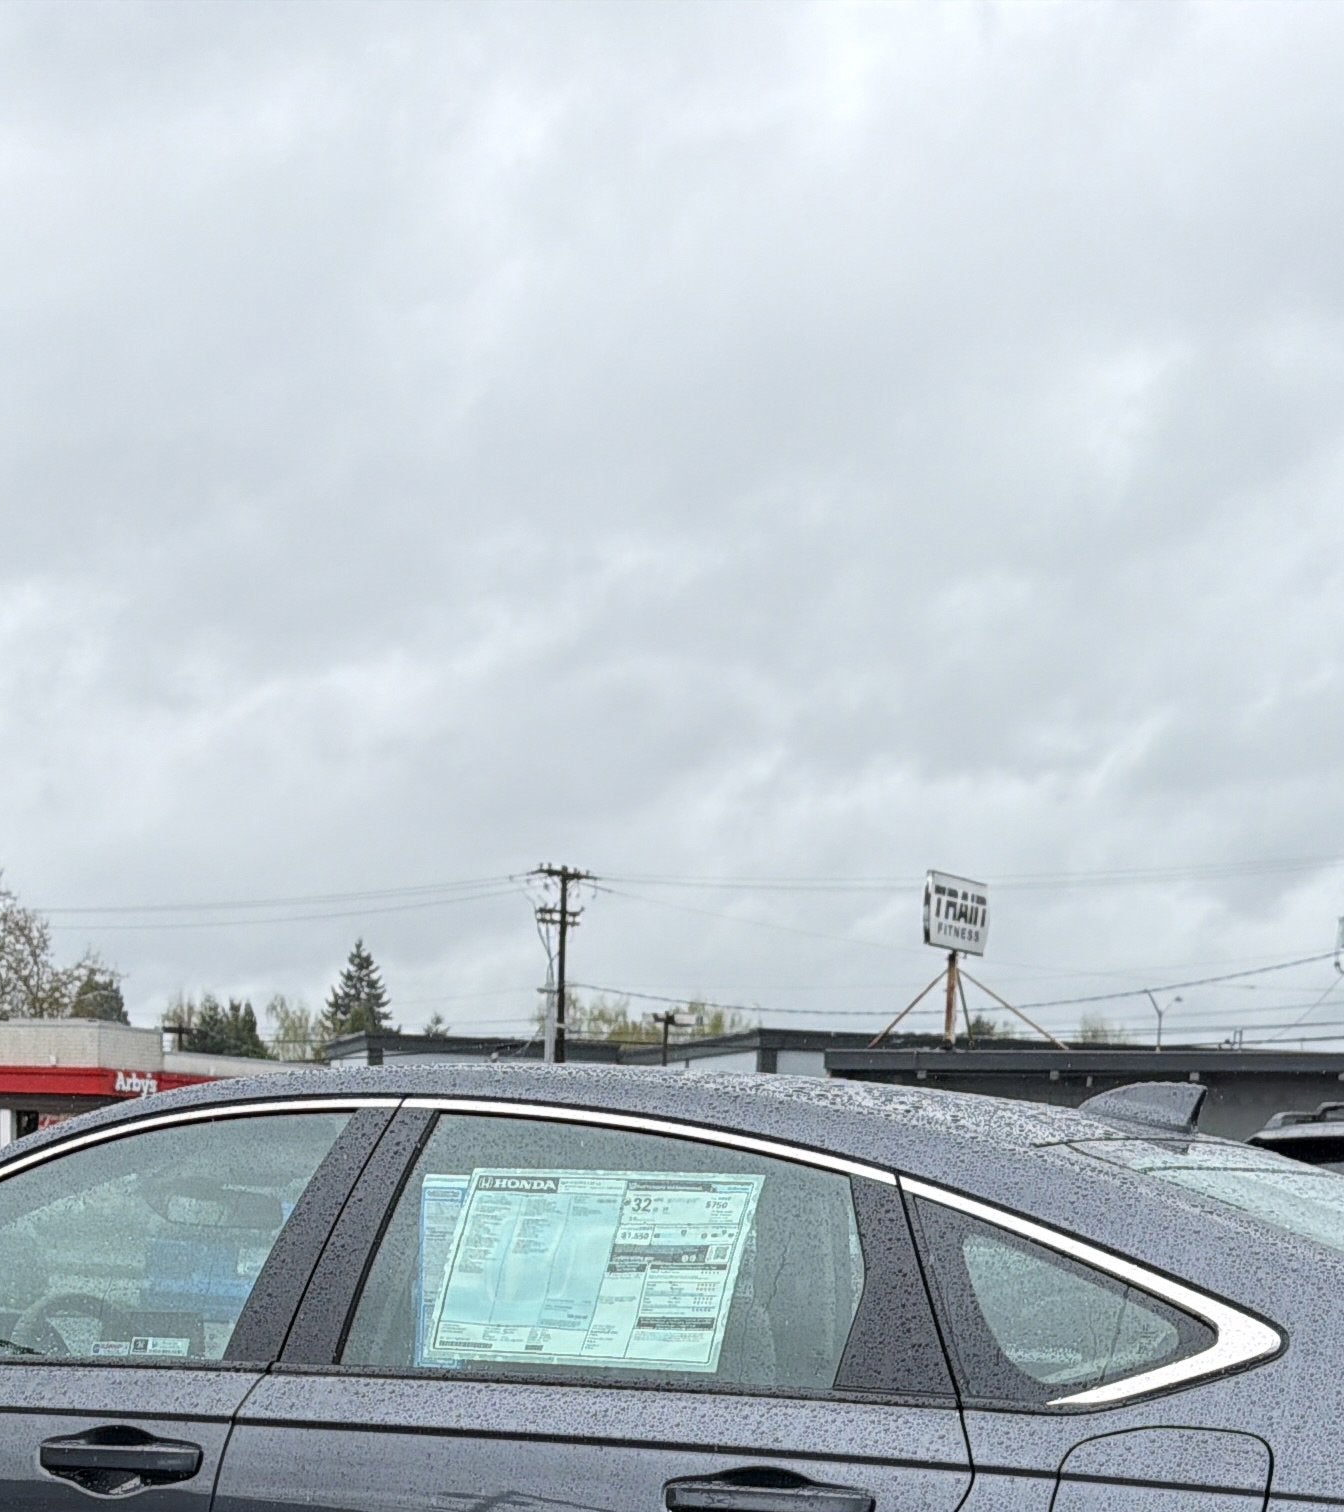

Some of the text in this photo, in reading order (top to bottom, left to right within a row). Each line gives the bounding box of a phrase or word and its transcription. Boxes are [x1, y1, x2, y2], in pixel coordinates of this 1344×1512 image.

[937, 921, 980, 942] FITNESS
[493, 1177, 557, 1191] HONDA
[631, 1197, 652, 1213] 32
